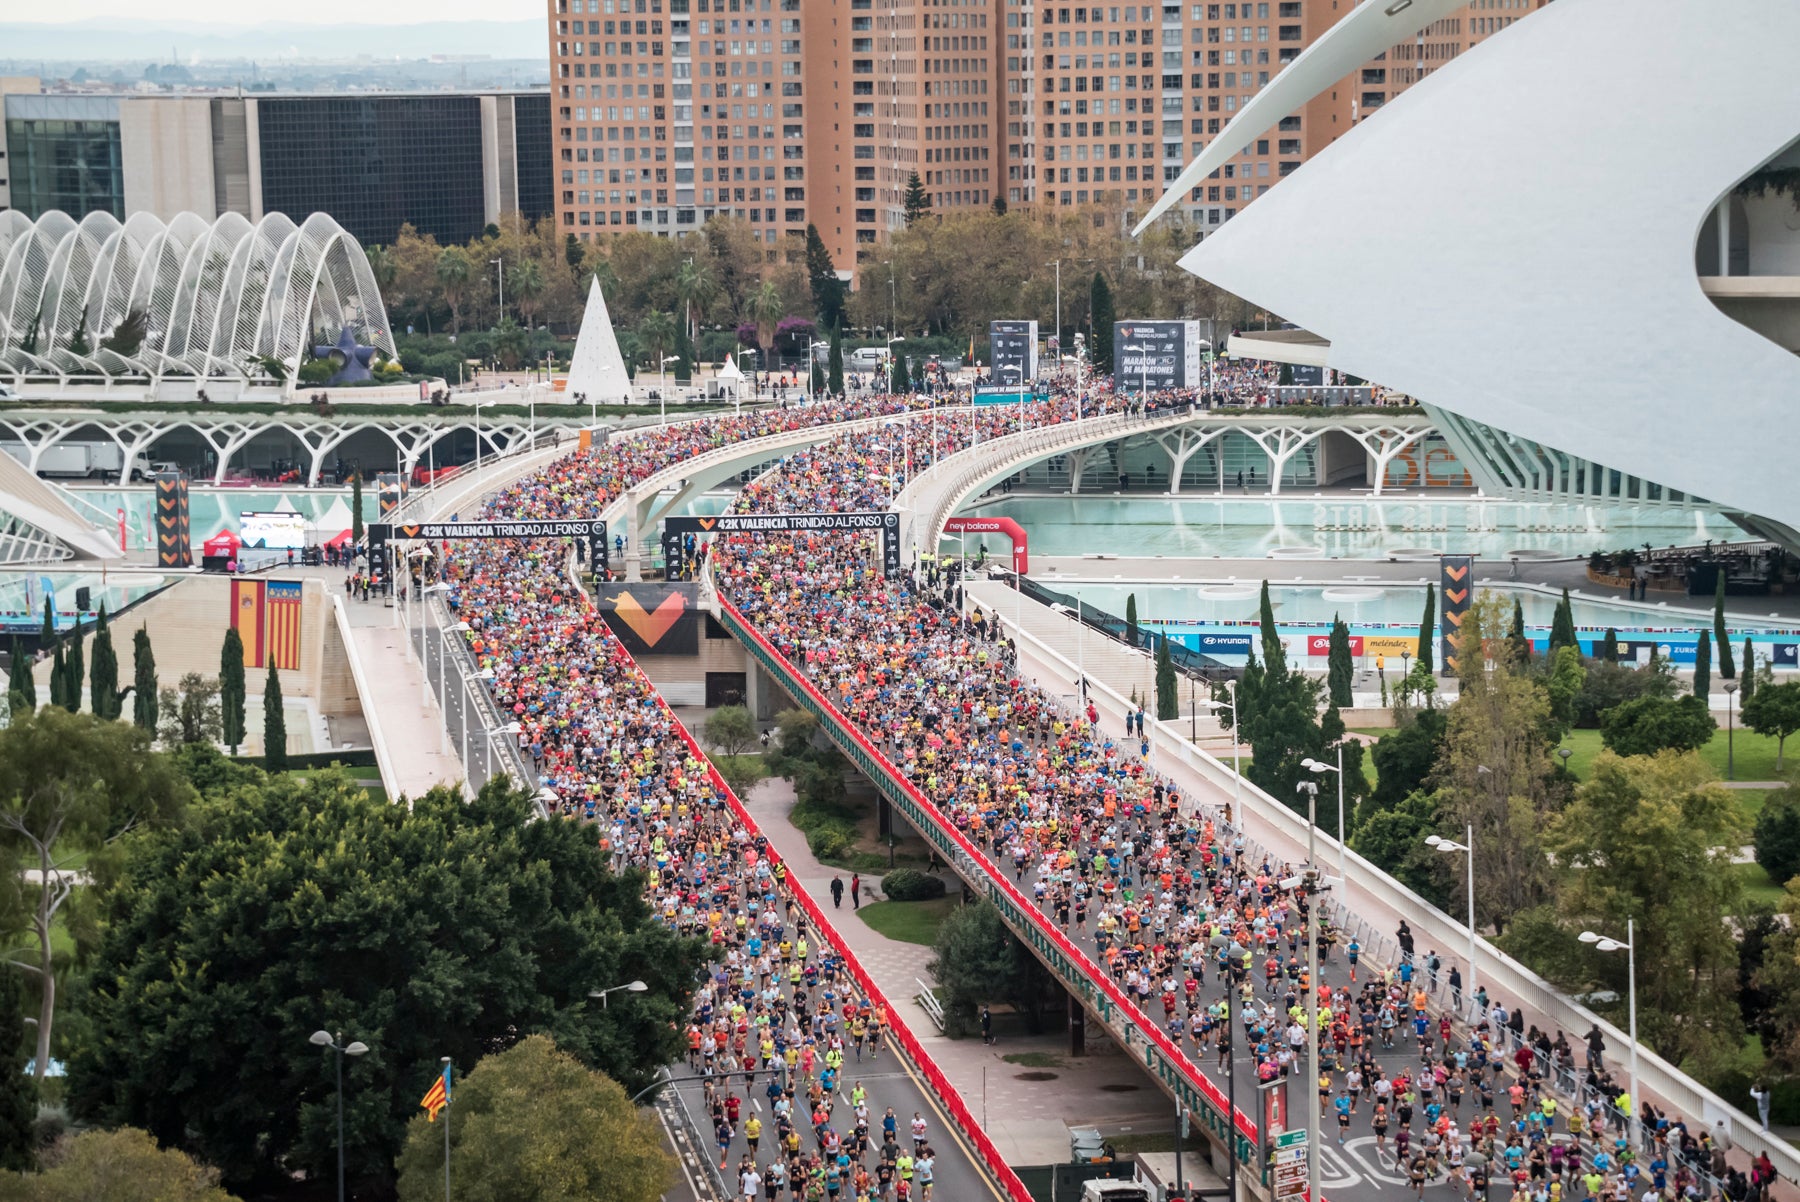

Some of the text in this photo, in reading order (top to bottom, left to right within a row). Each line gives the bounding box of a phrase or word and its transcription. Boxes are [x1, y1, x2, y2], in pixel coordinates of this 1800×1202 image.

[1123, 365, 1132, 373] DE
[717, 515, 882, 530] 42K VALENCIA TRINIDAD ALFONSO
[949, 521, 1000, 530] new balance
[422, 523, 589, 537] 42K VALENCIA TRINIDAD ALFONSO
[1217, 637, 1250, 645] HYUNDAI
[1369, 639, 1408, 648] meléndez
[1673, 646, 1698, 654] ZURIC
